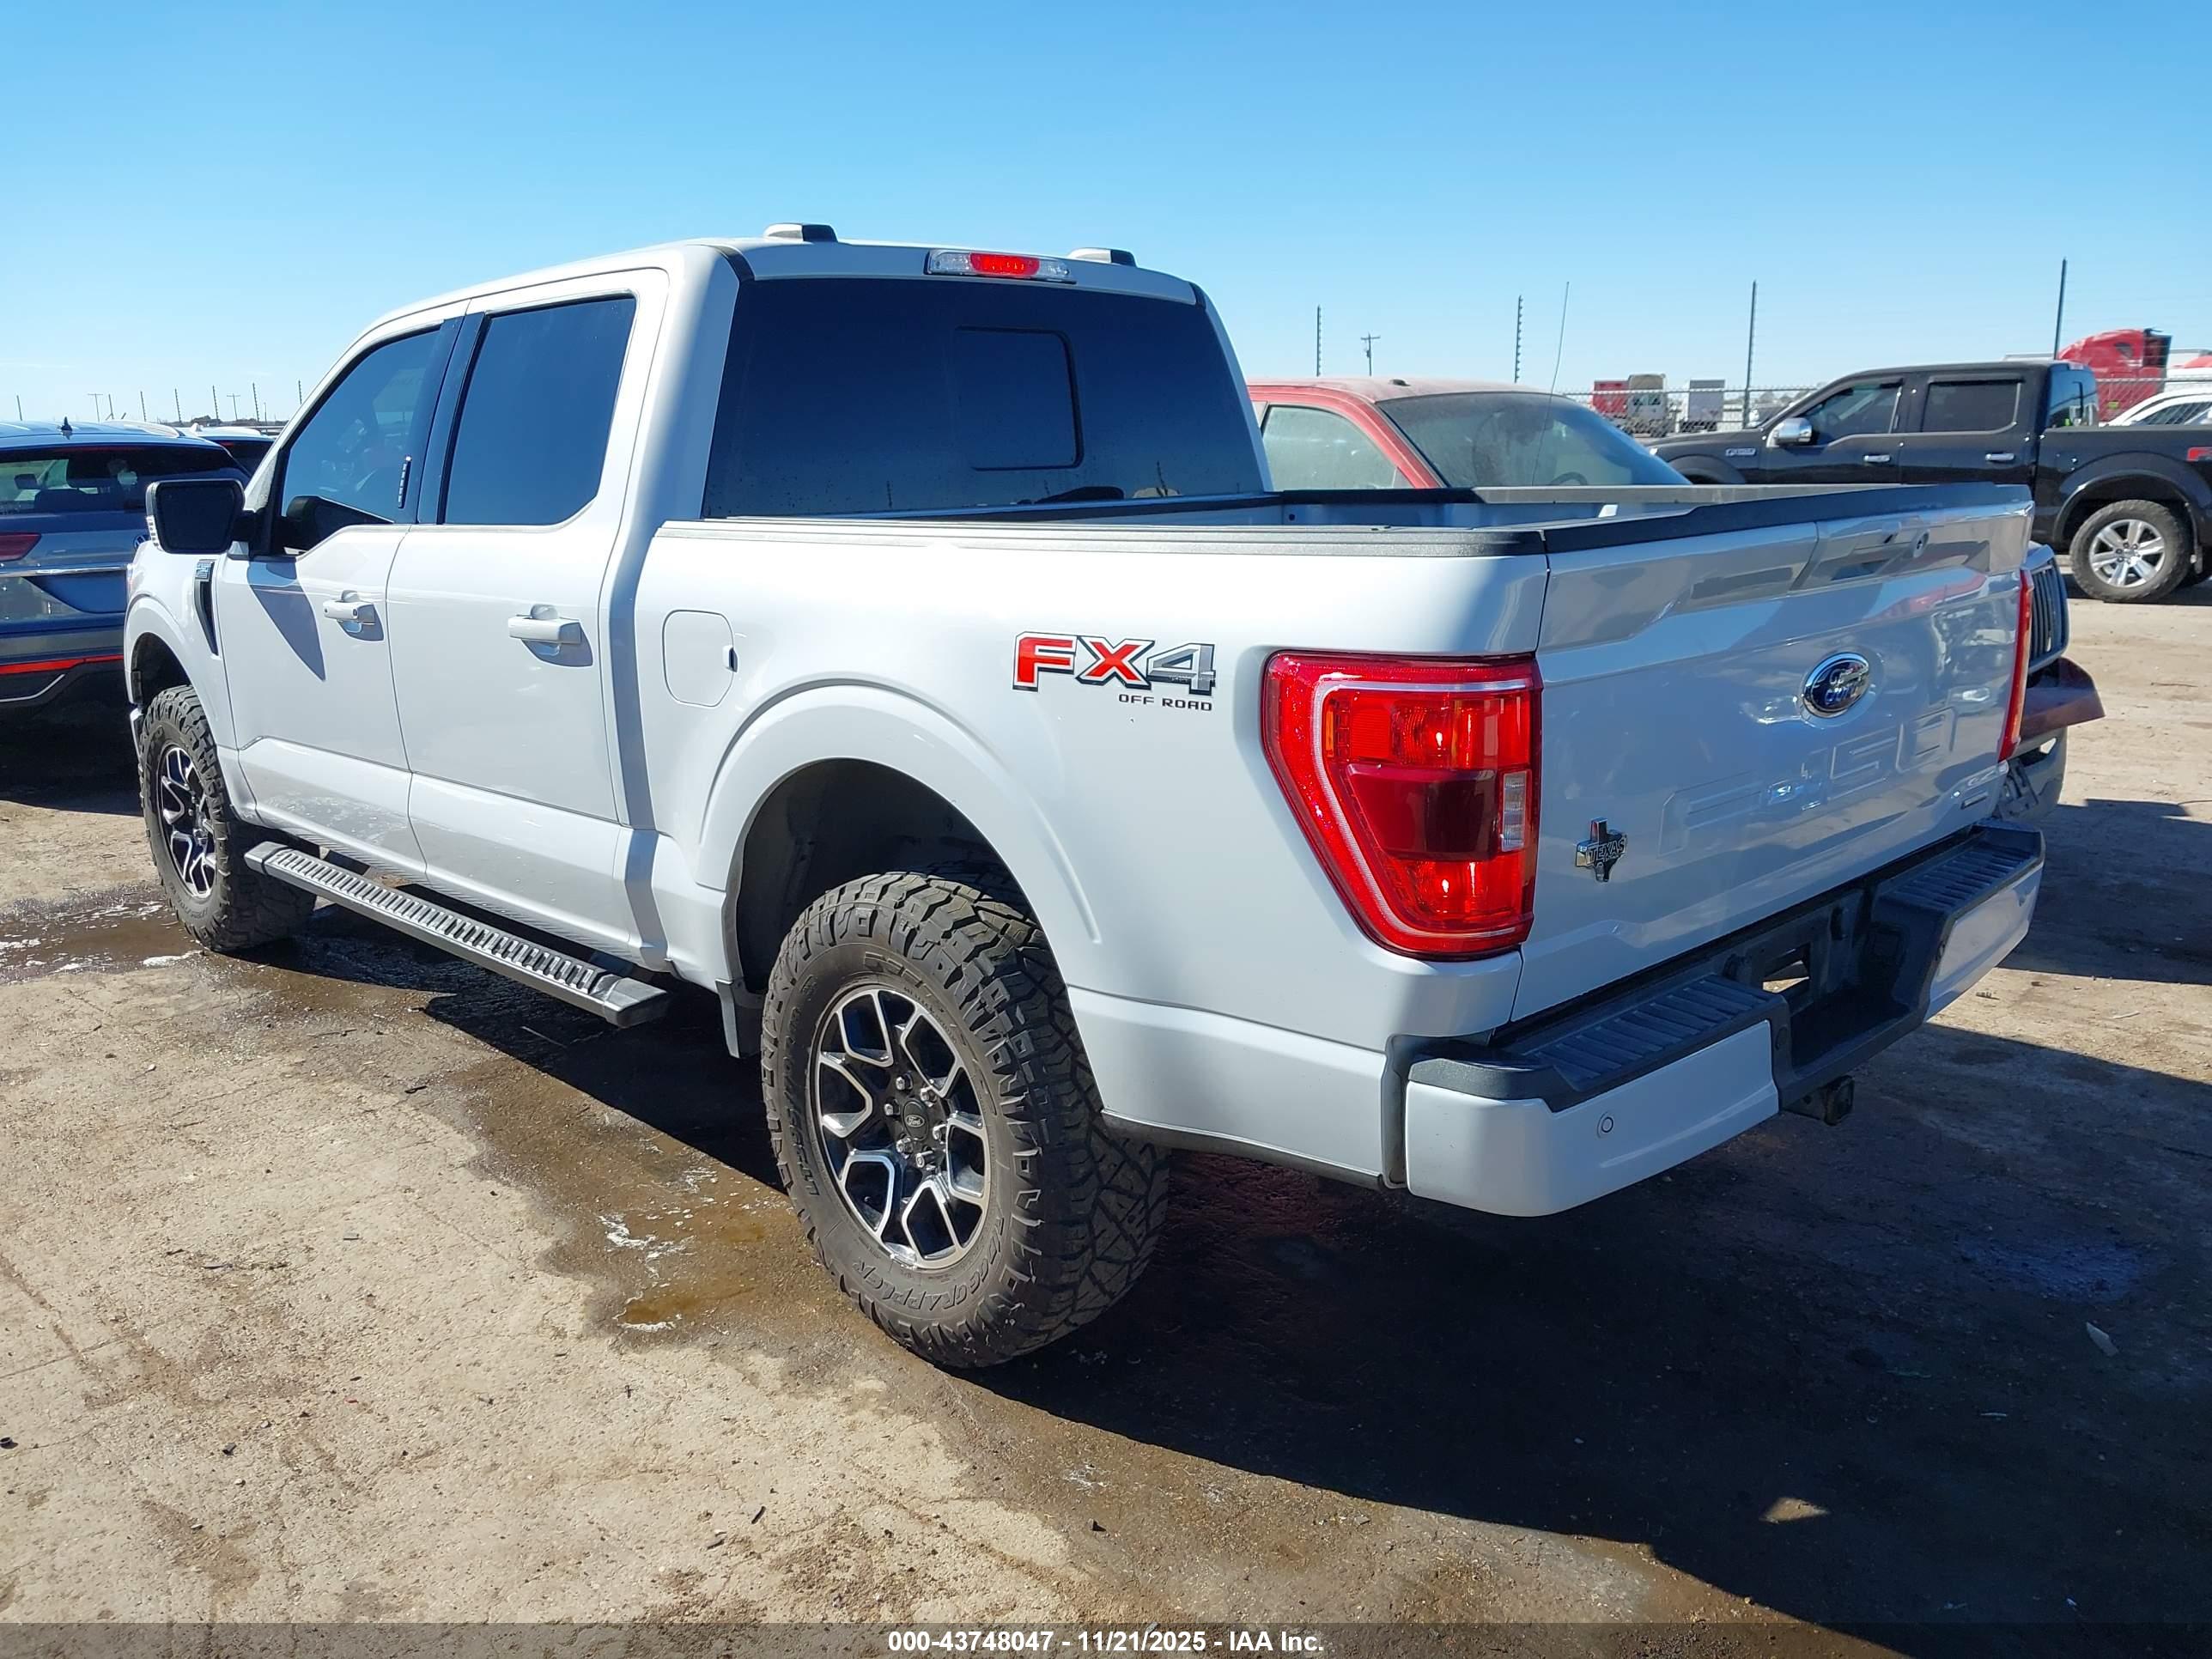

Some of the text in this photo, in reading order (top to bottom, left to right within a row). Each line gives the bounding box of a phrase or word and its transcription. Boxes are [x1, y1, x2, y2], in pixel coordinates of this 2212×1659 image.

[1012, 631, 1216, 696] FX4
[1118, 693, 1212, 712] OFF ROAD
[1657, 706, 1958, 858] F-150
[1587, 837, 1626, 864] TEXAS
